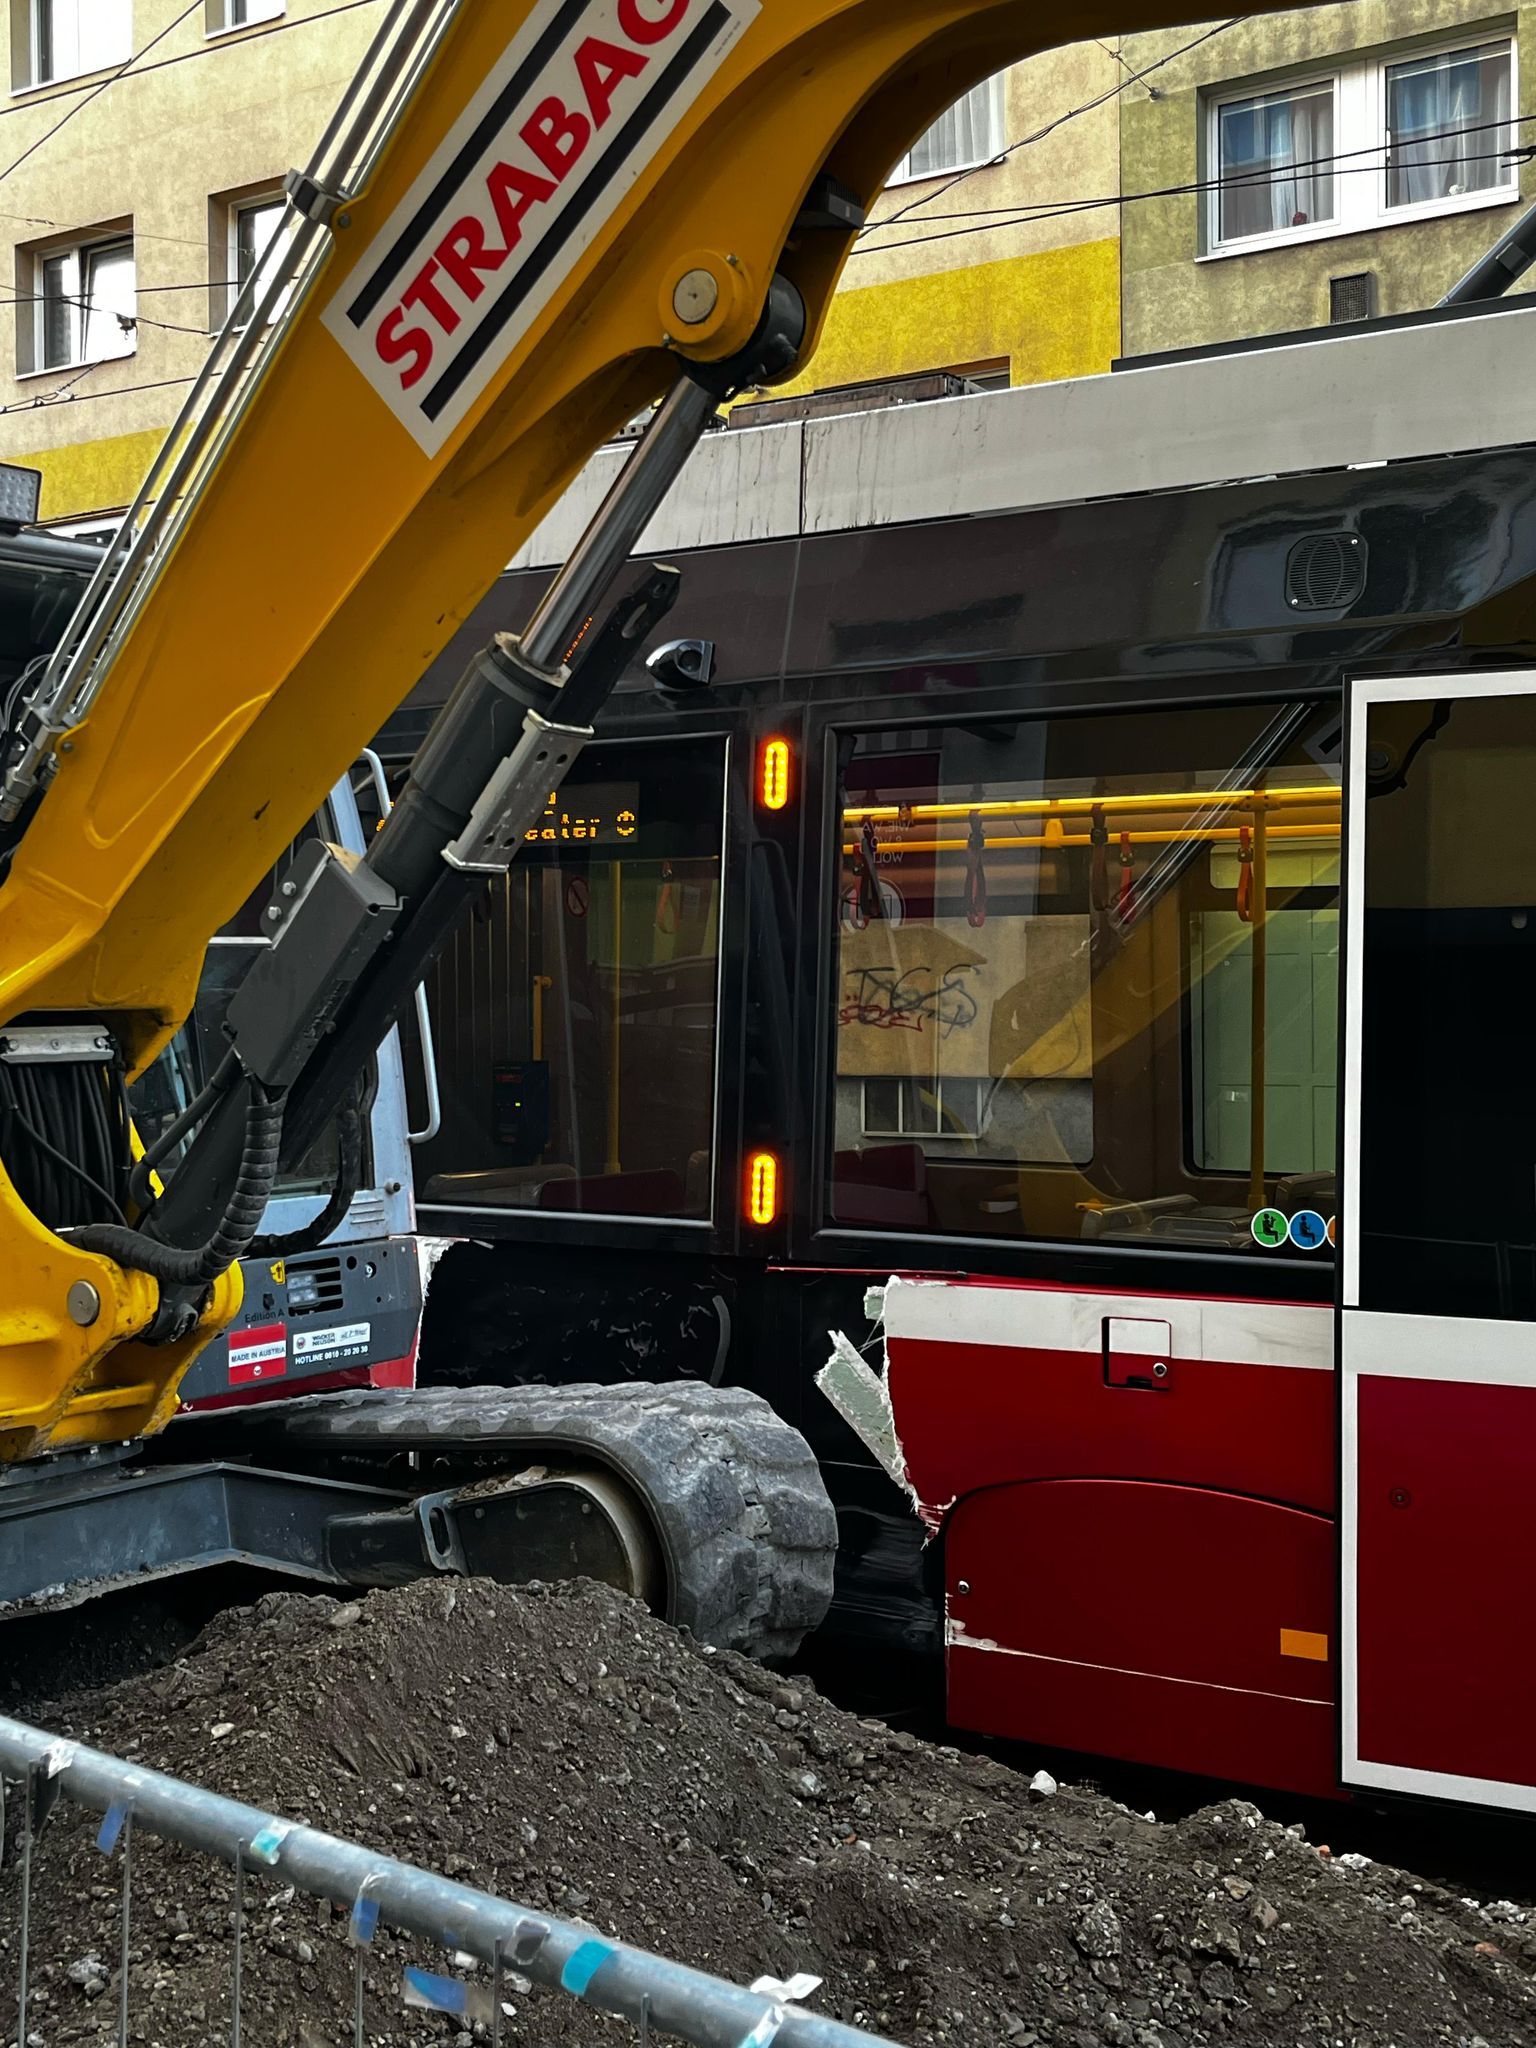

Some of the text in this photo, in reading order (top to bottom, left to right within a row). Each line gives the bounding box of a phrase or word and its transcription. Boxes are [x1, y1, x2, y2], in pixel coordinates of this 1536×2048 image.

[375, 0, 691, 391] STRABAG
[245, 1308, 285, 1323] Edition A
[231, 1353, 250, 1362] MADE
[258, 1346, 285, 1356] AUSTRIA
[294, 1353, 324, 1365] HOTLINE
